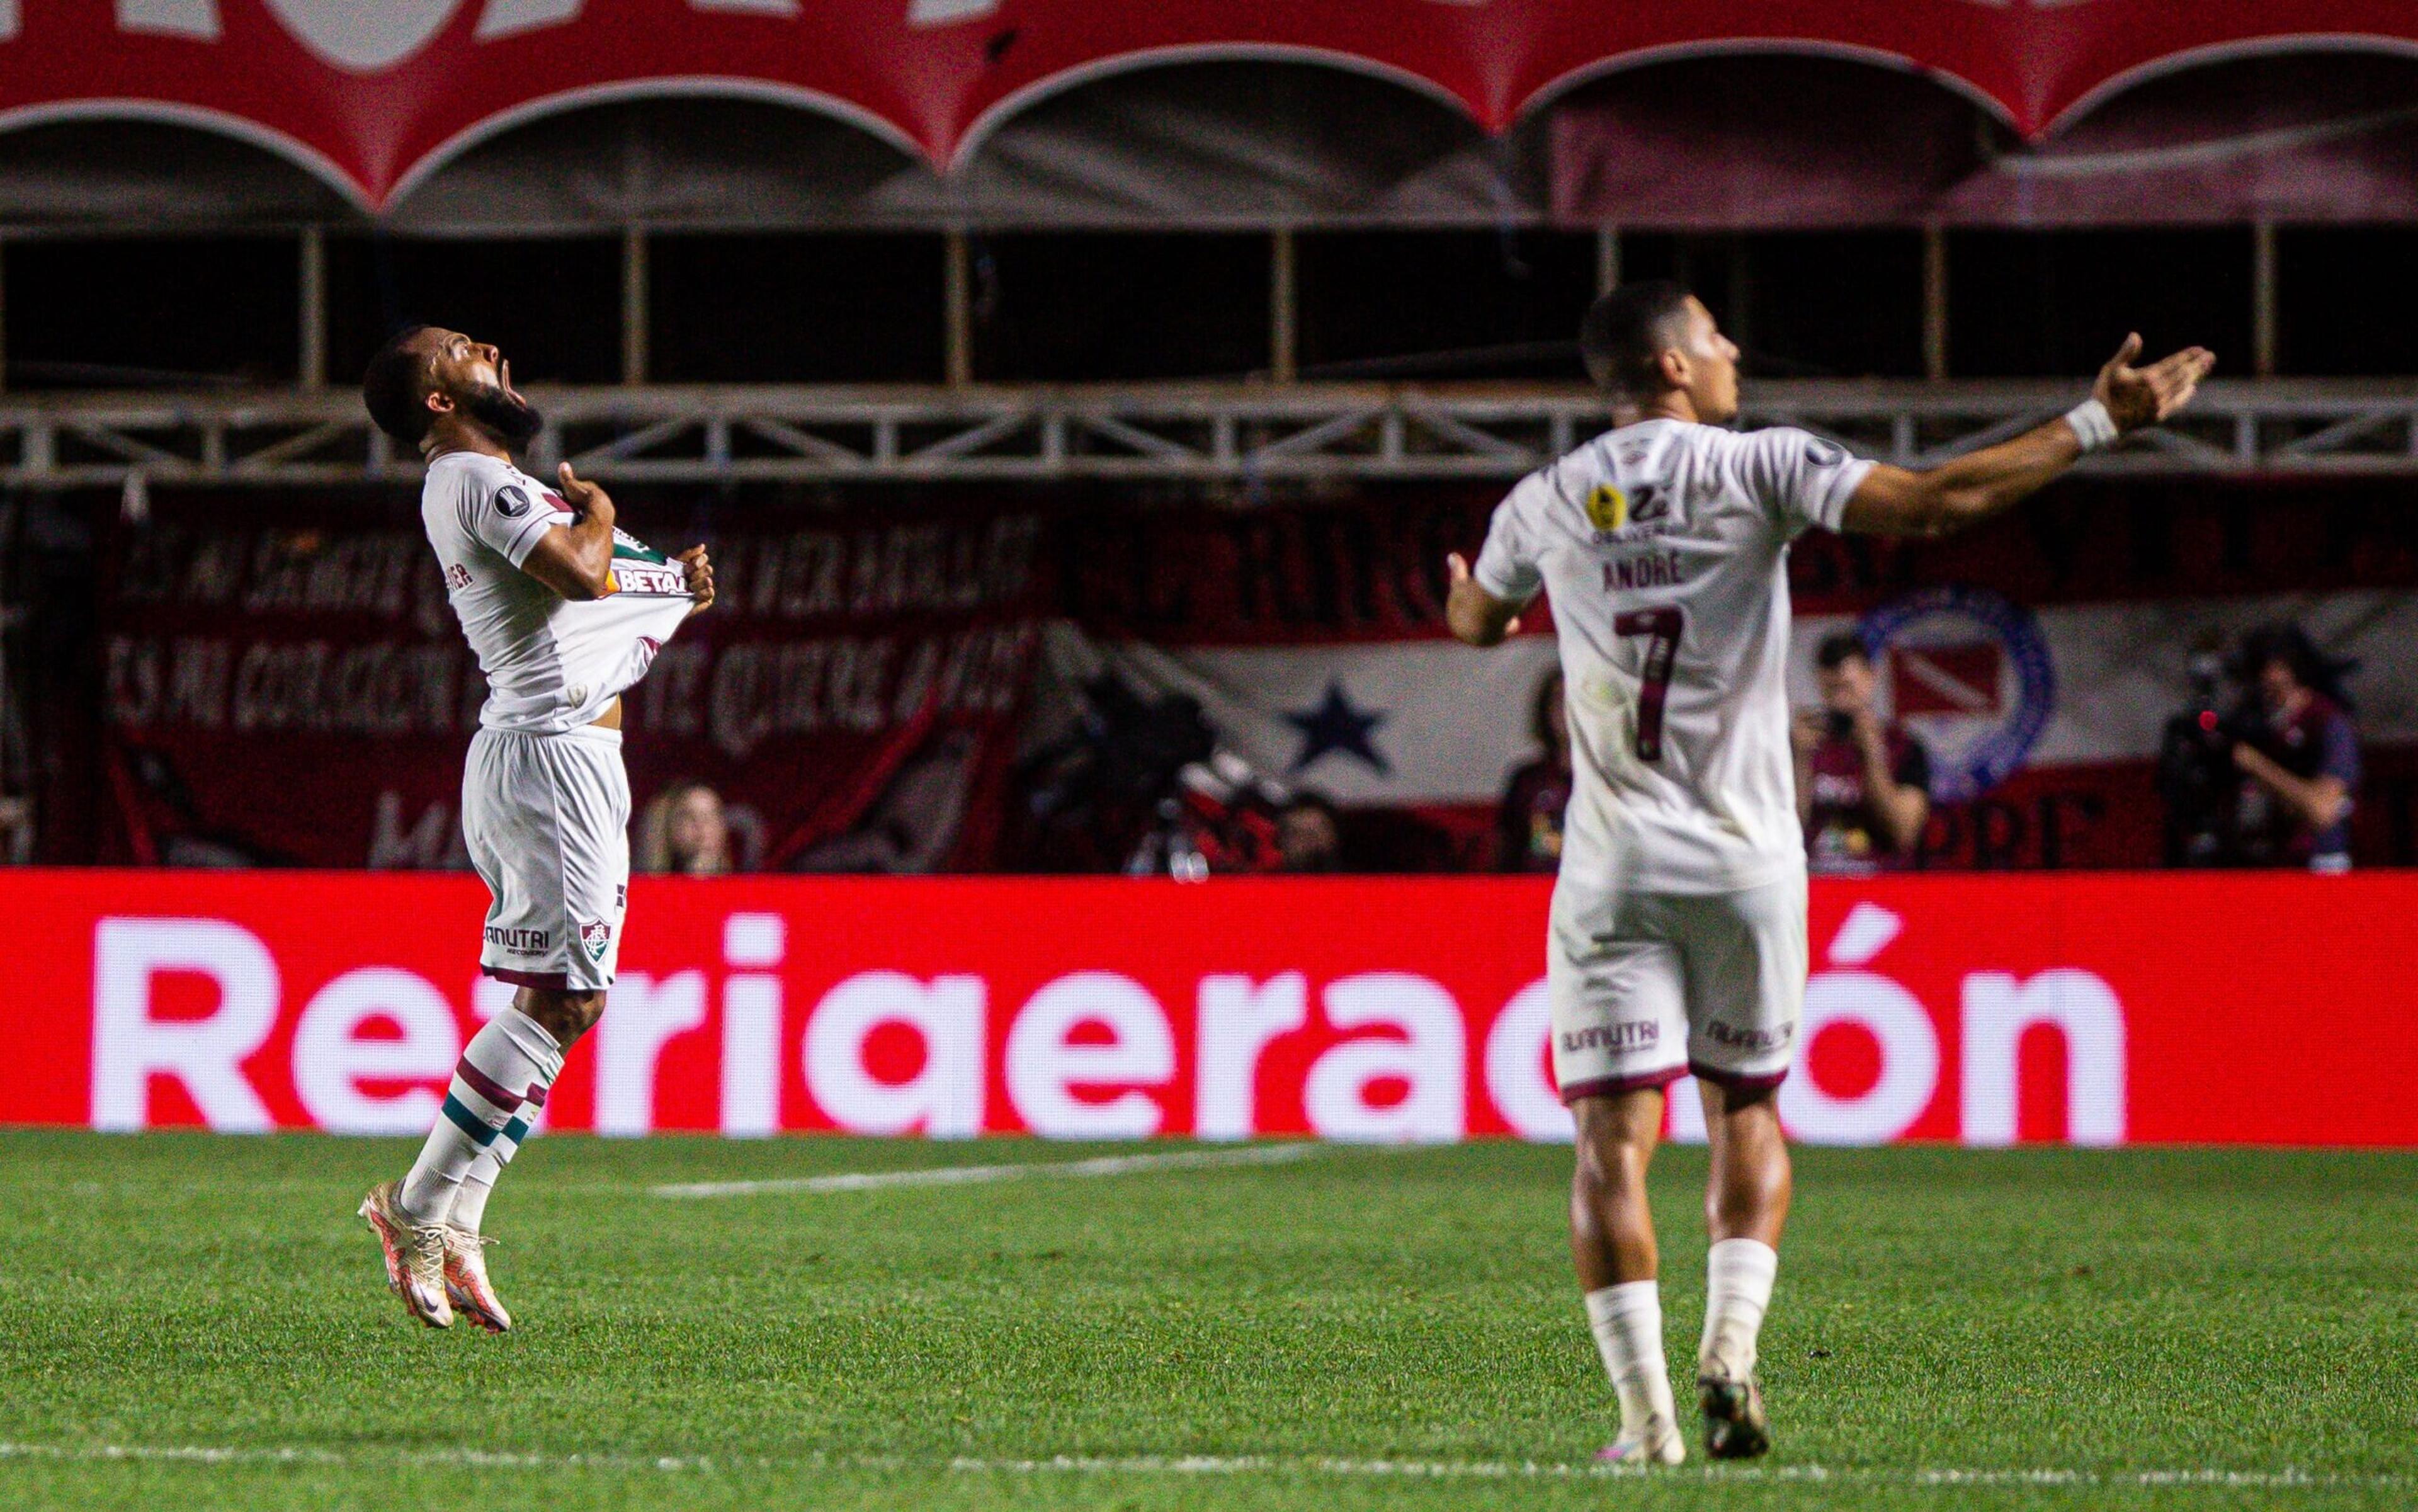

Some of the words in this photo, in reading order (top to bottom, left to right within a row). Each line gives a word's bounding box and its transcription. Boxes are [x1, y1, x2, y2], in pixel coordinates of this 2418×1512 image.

[1602, 546, 1684, 592] ANDRÉ
[1614, 603, 1683, 761] 7
[484, 926, 549, 948] ANUTRI
